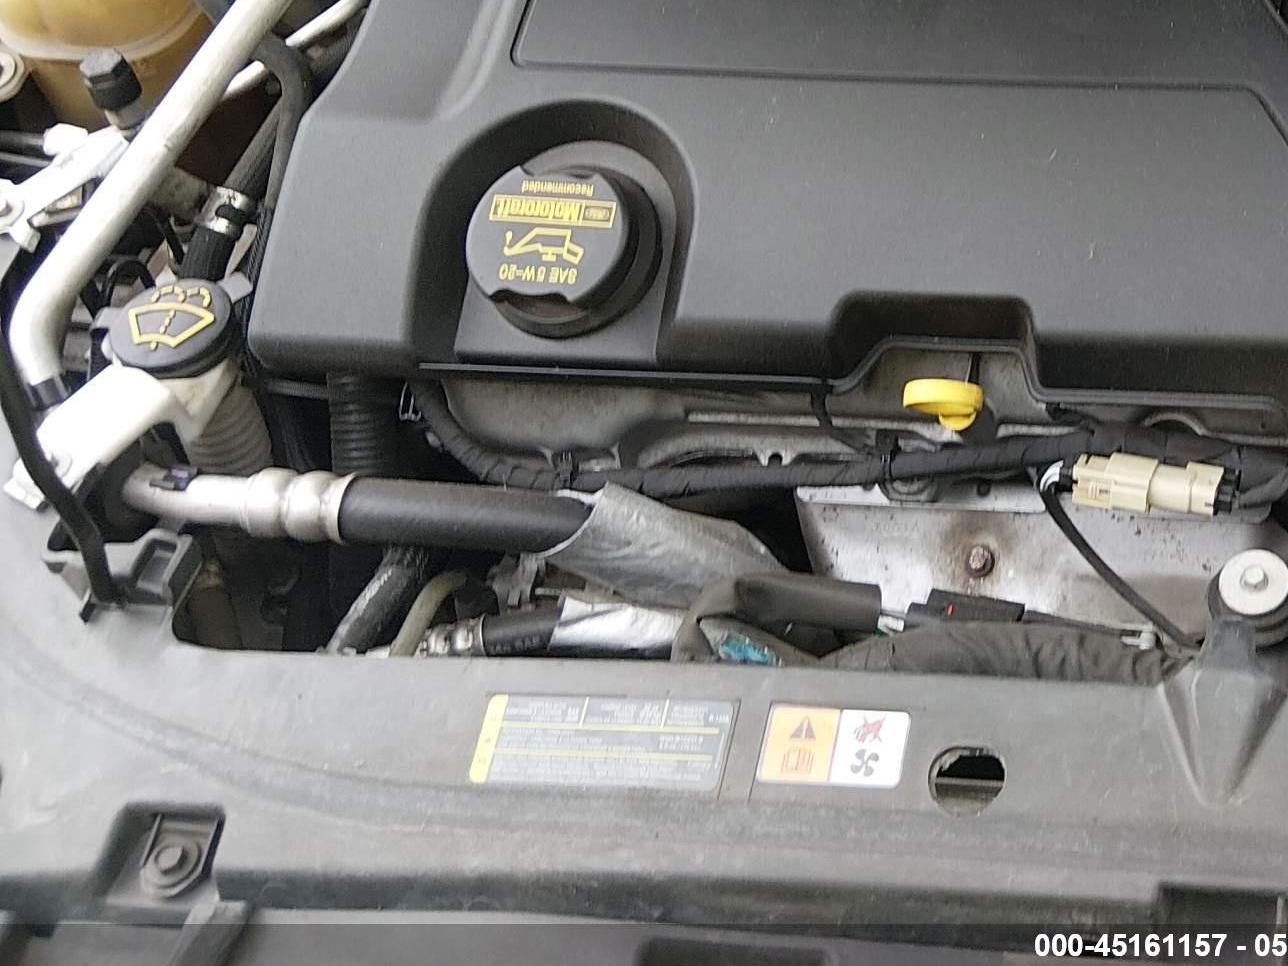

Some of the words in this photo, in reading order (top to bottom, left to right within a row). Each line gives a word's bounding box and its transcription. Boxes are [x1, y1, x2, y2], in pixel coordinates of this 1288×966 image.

[522, 180, 594, 197] Recommended
[498, 198, 580, 221] Motorcraft
[549, 266, 578, 285] SAE
